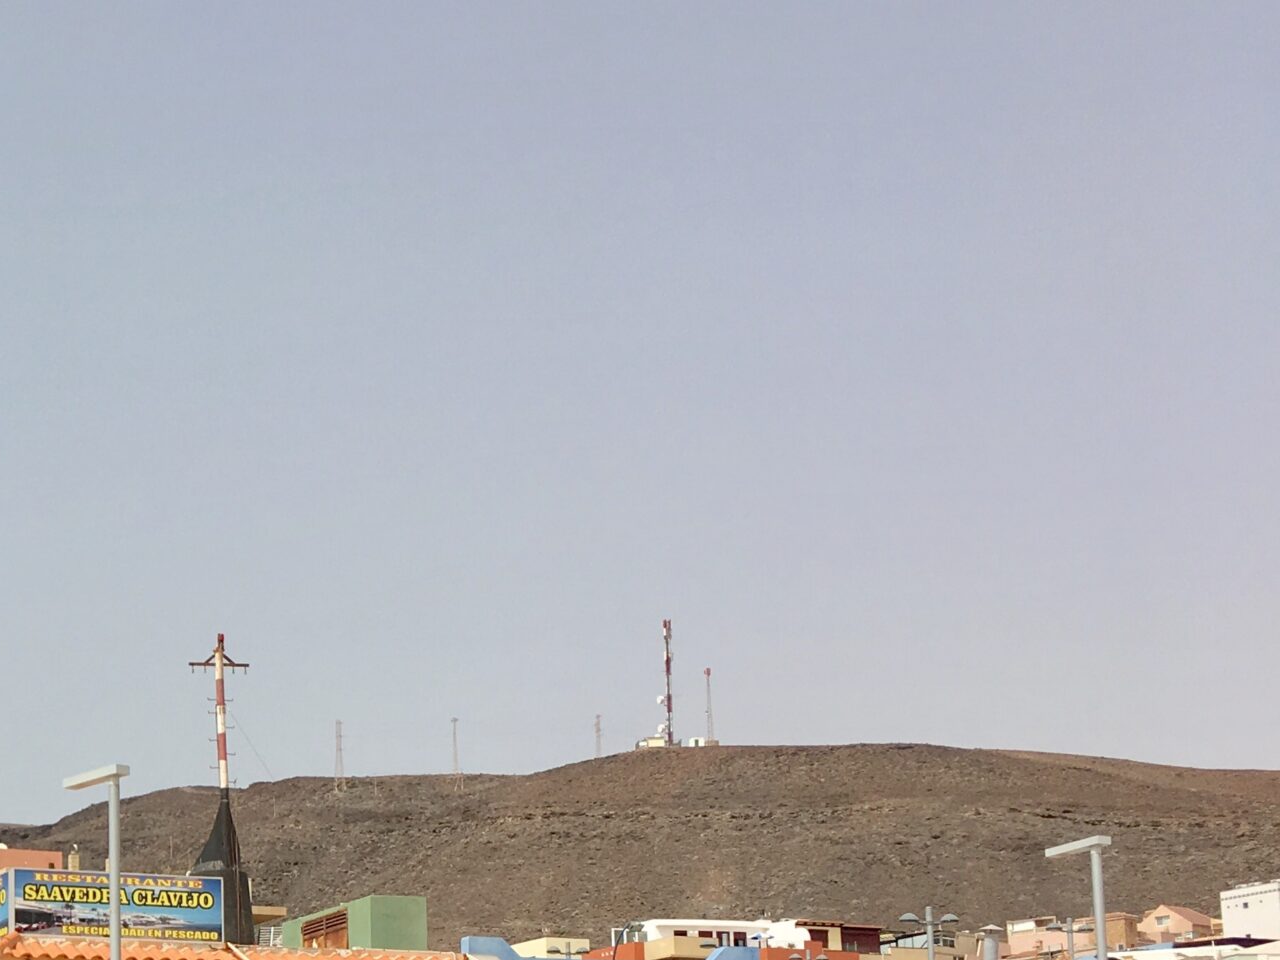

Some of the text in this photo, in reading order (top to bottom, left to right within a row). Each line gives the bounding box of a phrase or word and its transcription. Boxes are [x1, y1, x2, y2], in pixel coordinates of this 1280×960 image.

[132, 888, 215, 909] CLAVIJO
[62, 925, 219, 940] ESPECIADAD EN PESCADO
